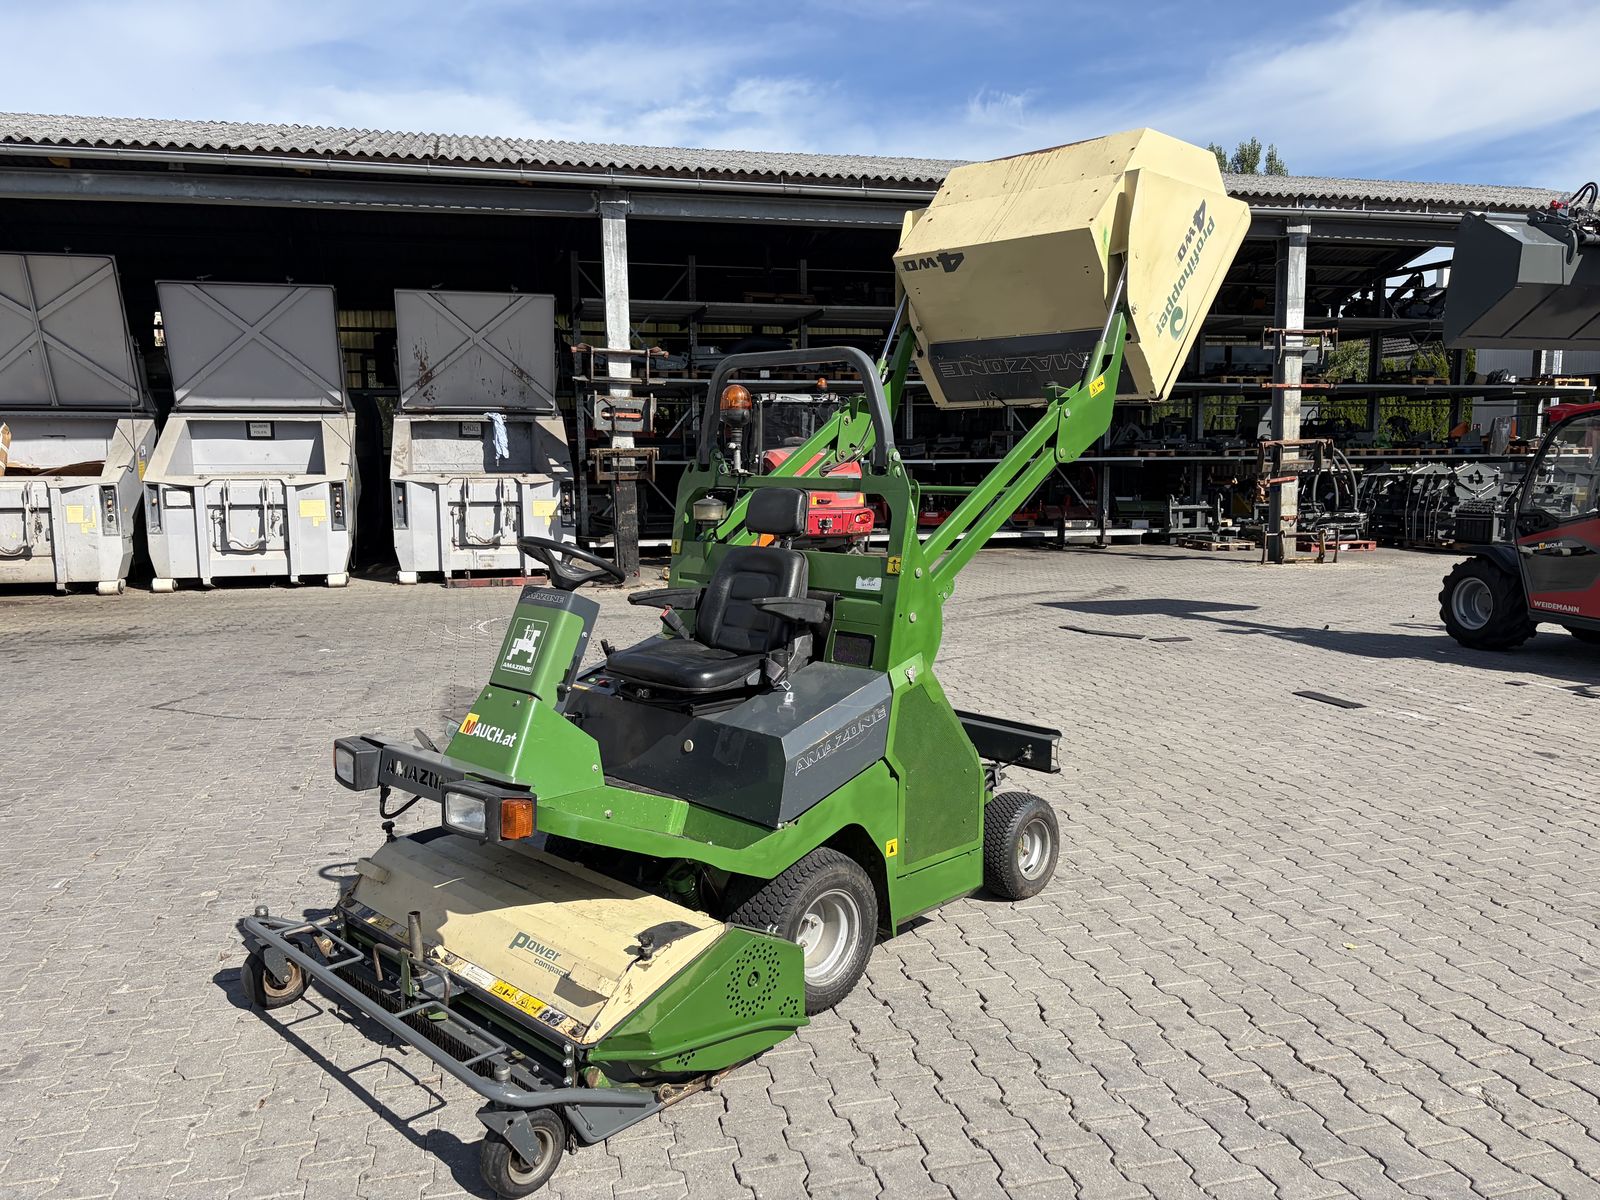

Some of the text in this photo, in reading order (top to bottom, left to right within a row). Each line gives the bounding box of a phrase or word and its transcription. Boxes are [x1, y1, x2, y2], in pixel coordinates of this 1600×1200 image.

[1176, 199, 1206, 262] 4WD
[903, 252, 965, 273] 4WD
[1156, 215, 1216, 337] profihopper
[939, 352, 1092, 378] MAZONE
[1533, 599, 1580, 614] WEIDEMANN
[502, 662, 533, 673] AMAZONE
[463, 718, 517, 748] MAUCH.at
[795, 705, 887, 776] AMAZONE
